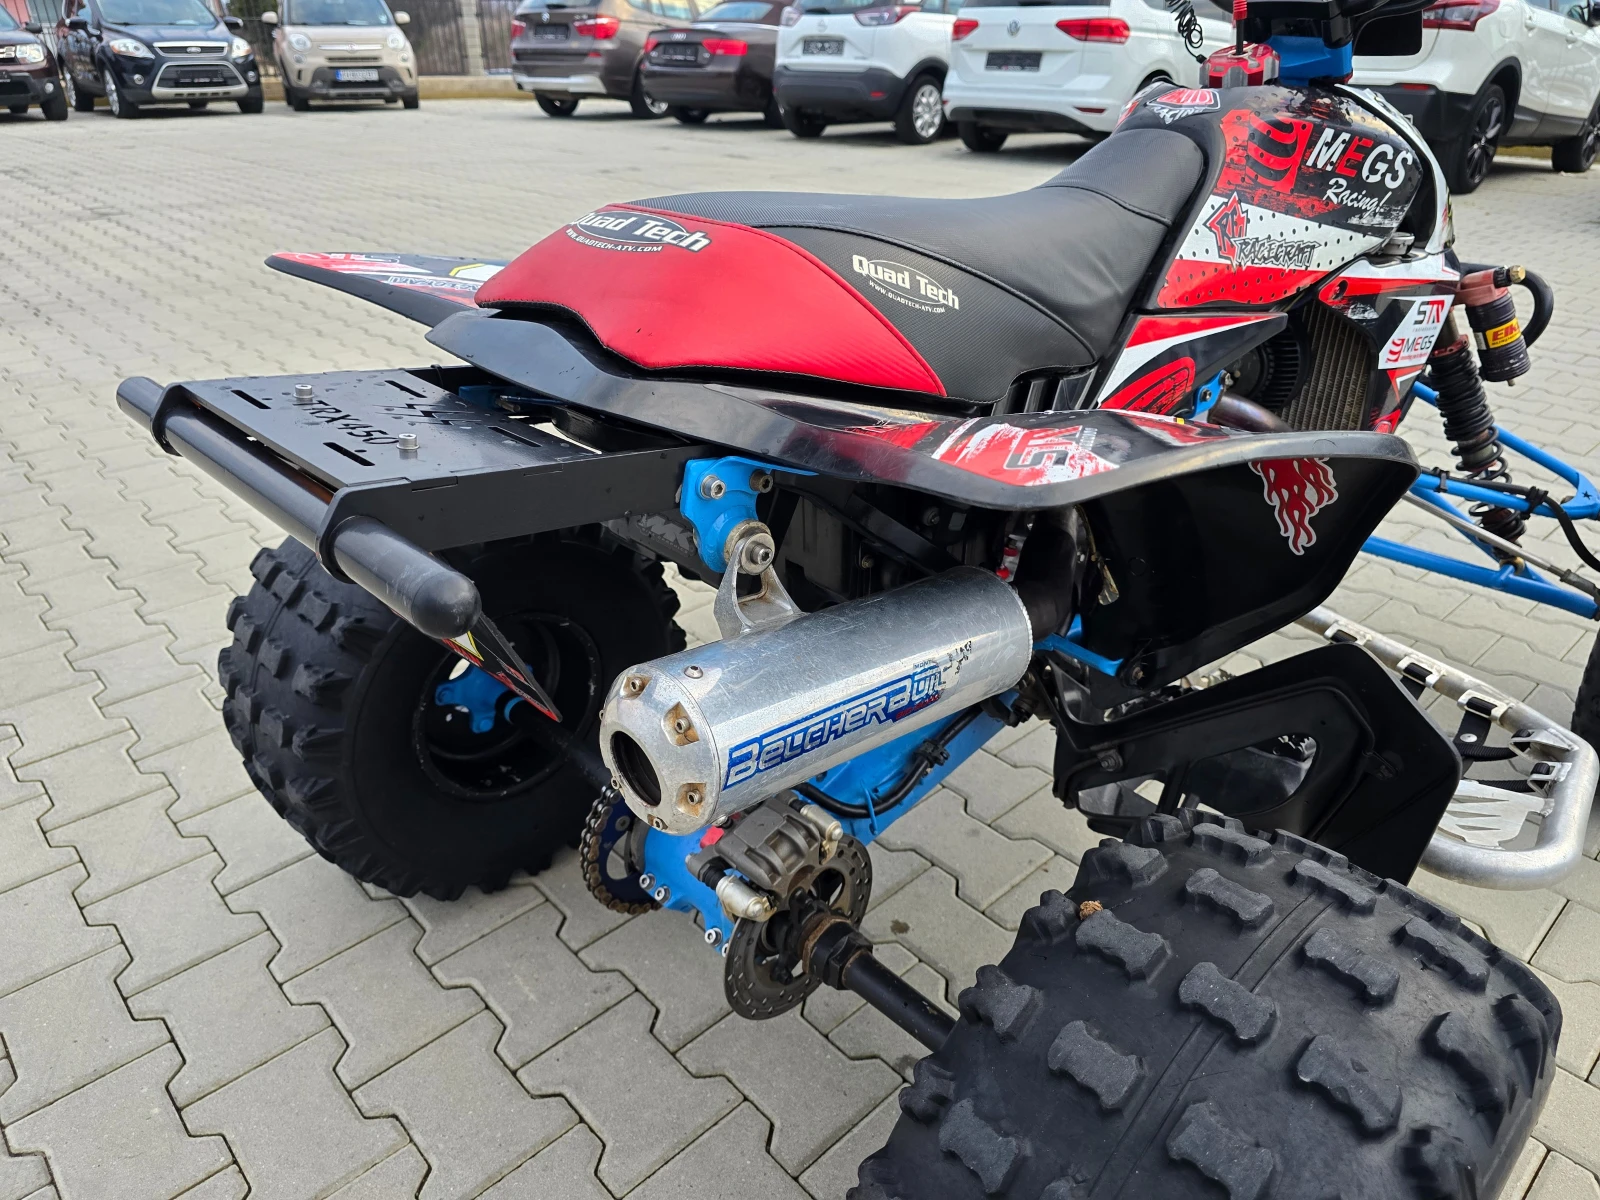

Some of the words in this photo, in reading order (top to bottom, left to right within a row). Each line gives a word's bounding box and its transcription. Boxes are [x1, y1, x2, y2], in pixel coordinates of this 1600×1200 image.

[1306, 128, 1413, 189] MEGS
[1323, 178, 1392, 218] Racing!
[632, 219, 711, 252] Tech
[1232, 238, 1321, 269] RACECRAFT
[852, 254, 911, 290] Quad
[916, 275, 960, 310] Tech
